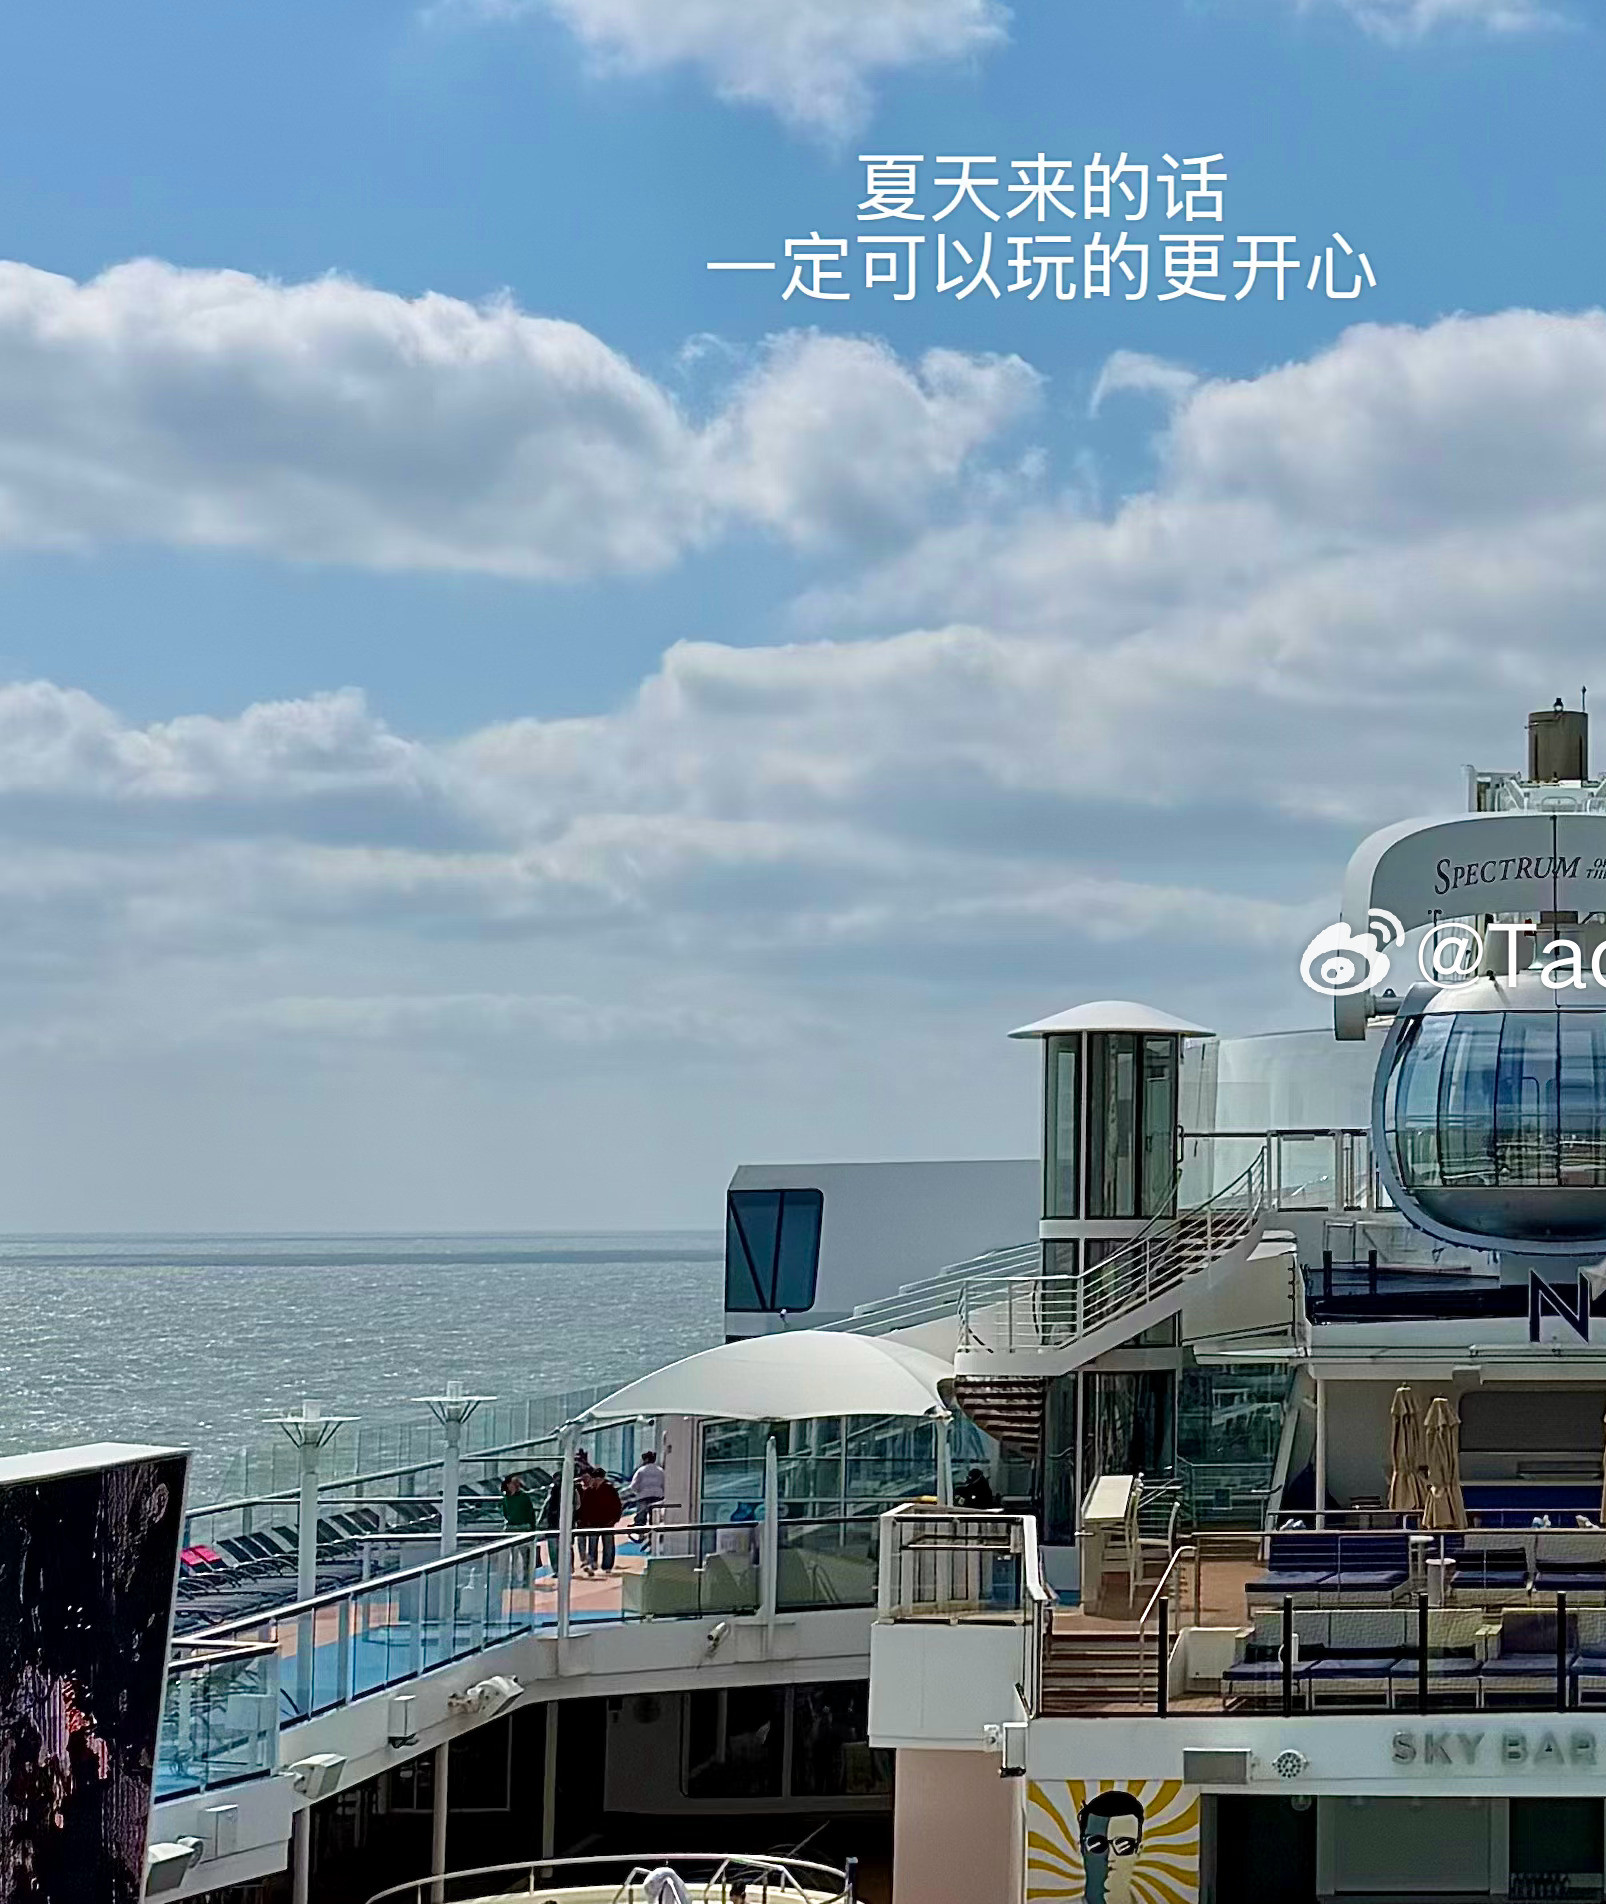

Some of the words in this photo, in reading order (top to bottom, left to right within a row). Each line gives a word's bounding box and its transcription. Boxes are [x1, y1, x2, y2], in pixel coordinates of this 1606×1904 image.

[1434, 856, 1581, 895] SPECTRUM
[1392, 1731, 1485, 1766] SKY
[1502, 1731, 1597, 1766] BAR
